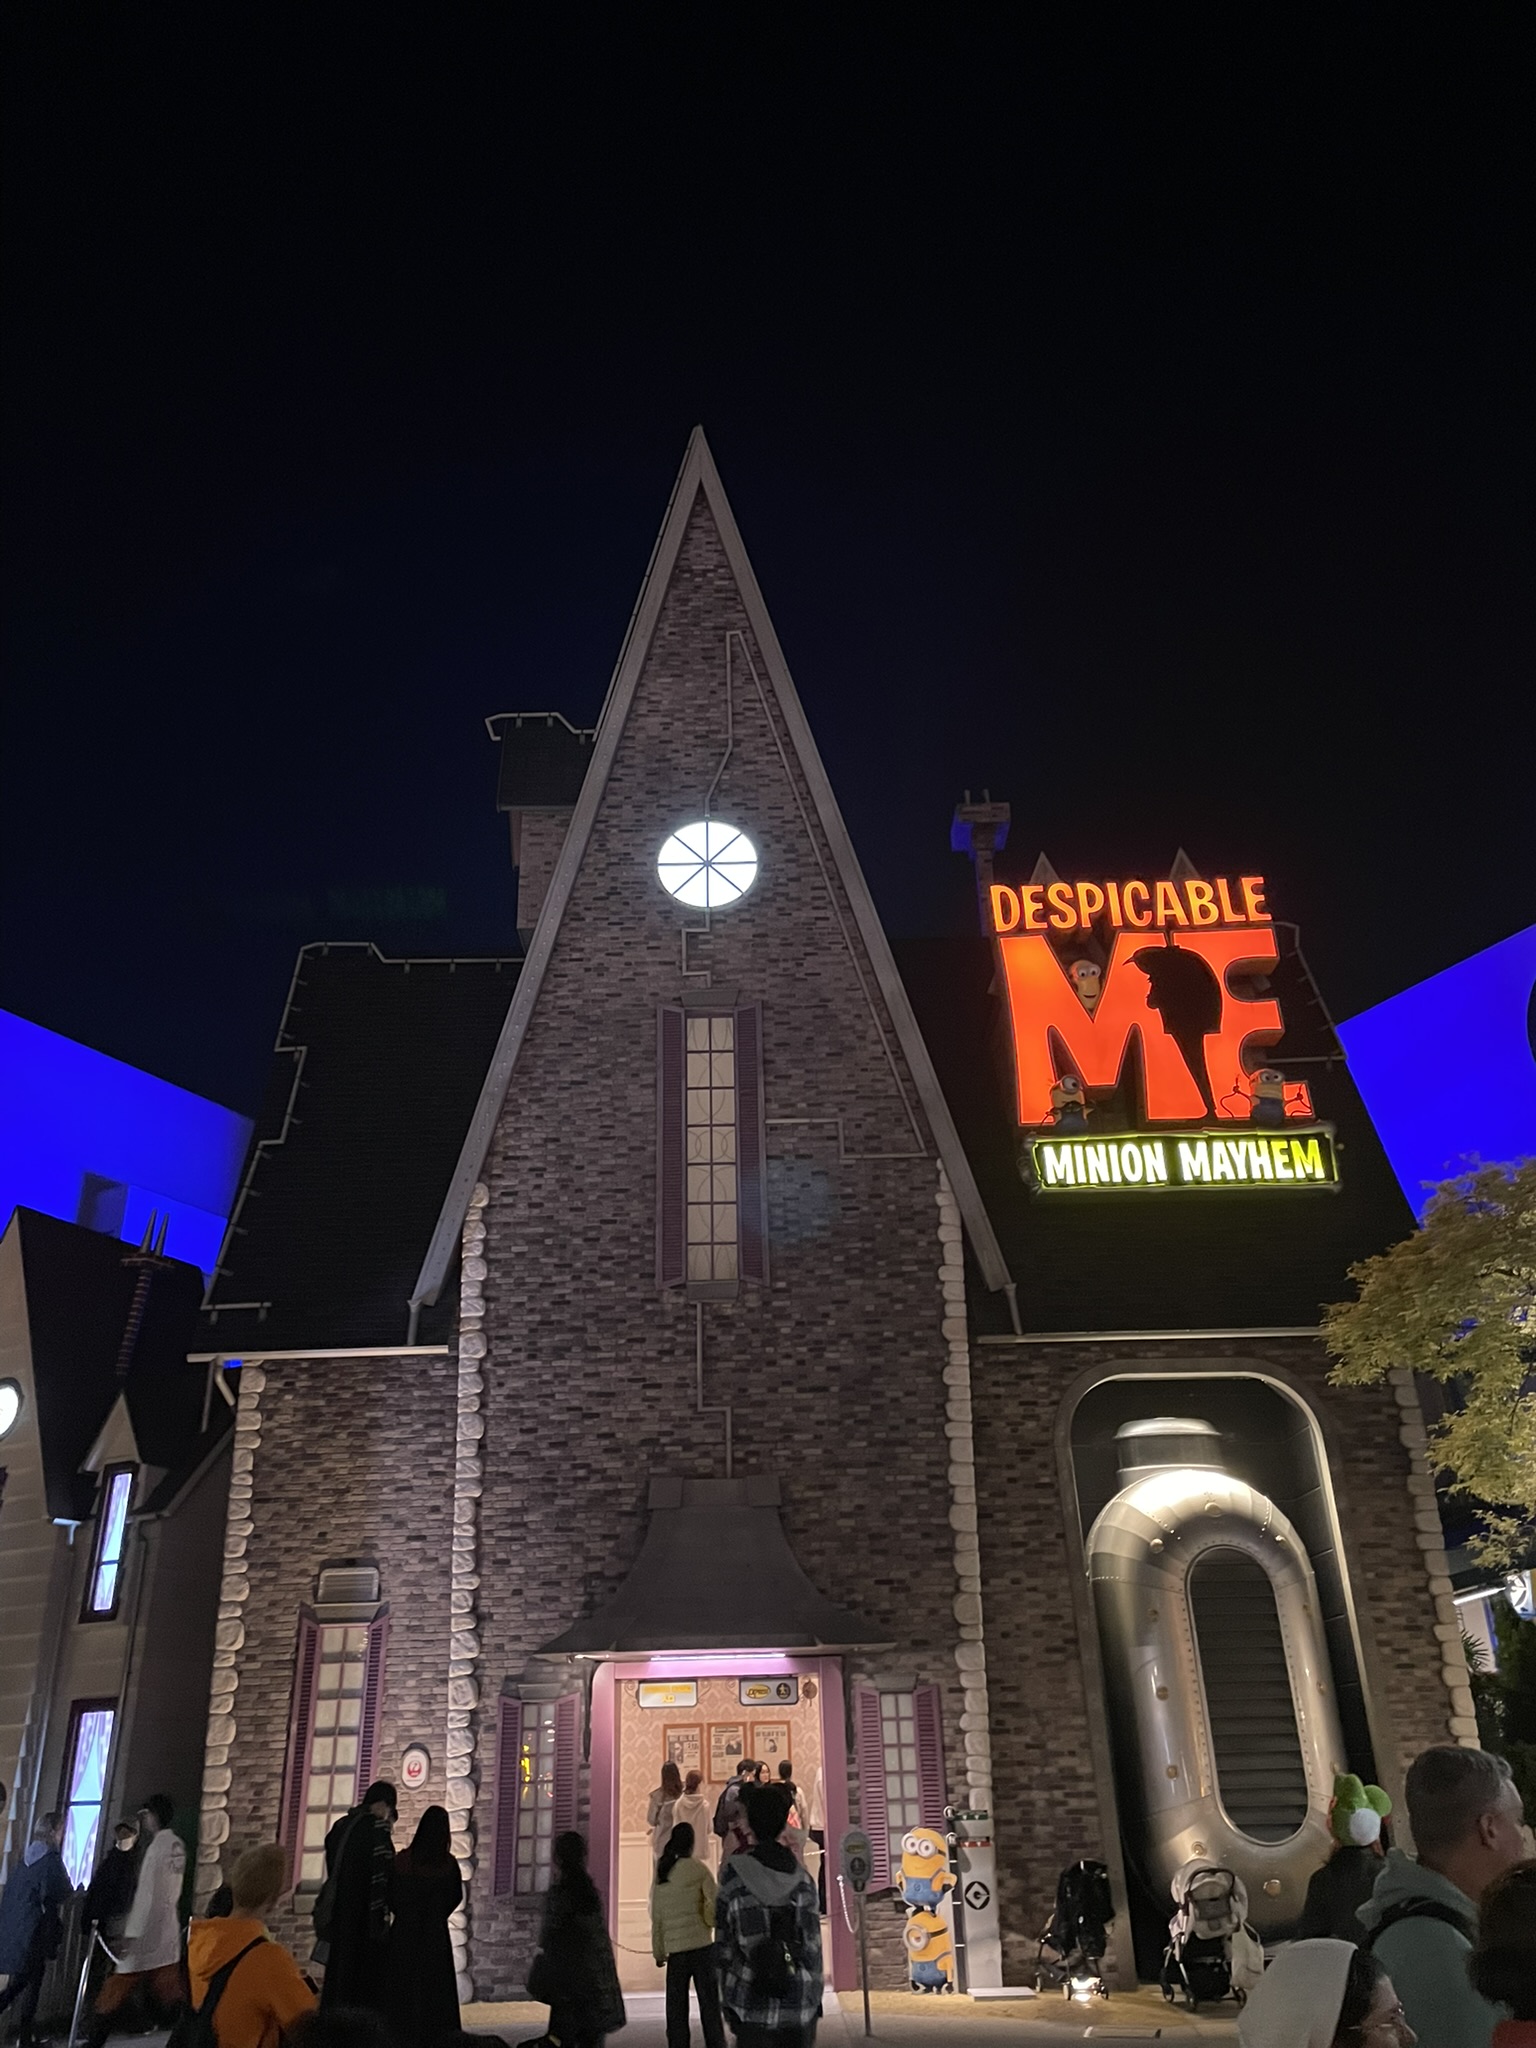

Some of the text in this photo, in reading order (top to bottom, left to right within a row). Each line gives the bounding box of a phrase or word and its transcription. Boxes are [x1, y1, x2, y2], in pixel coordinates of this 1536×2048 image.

[990, 876, 1272, 932] DESPICABLE
[1000, 928, 1315, 1126] ME
[1043, 1139, 1325, 1184] MINION MAYHEM
